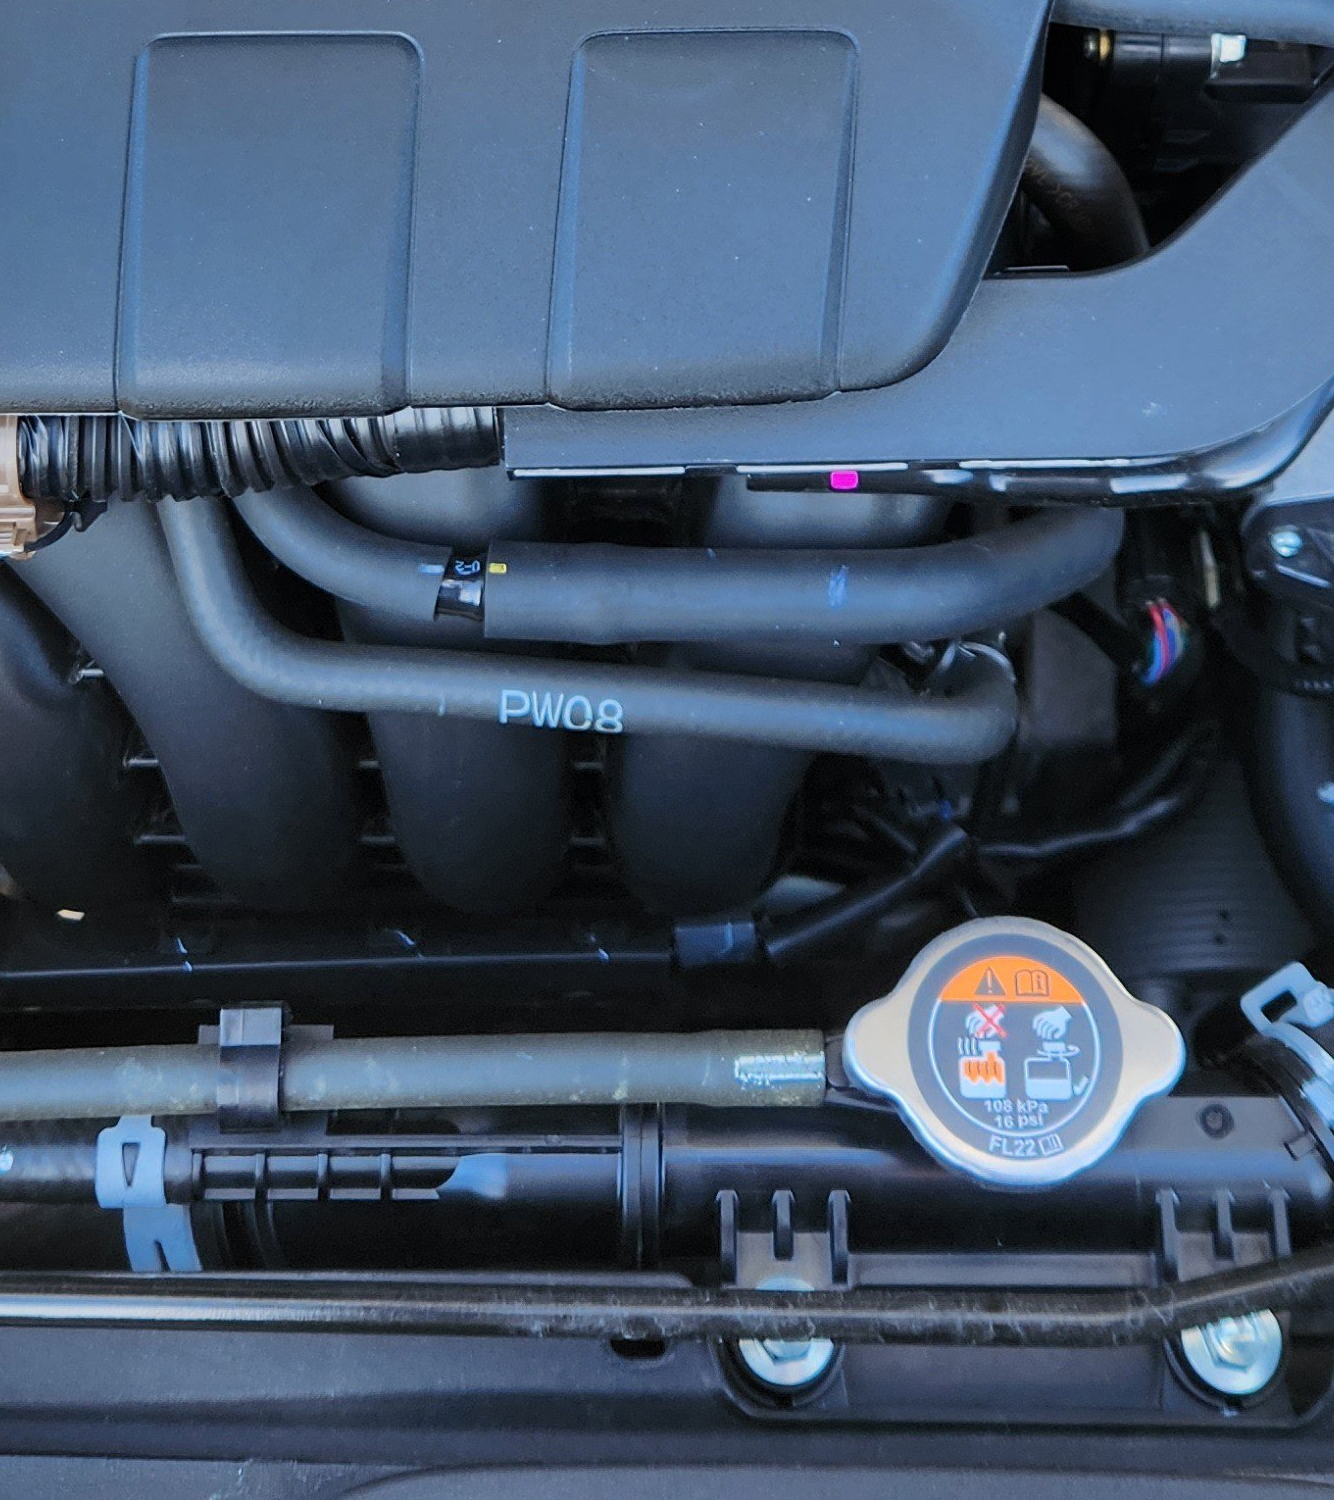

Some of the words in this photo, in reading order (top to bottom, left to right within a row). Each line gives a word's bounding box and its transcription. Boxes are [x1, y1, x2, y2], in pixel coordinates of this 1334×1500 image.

[984, 1100, 1013, 1113] 108
[1018, 1100, 1048, 1113] kPa
[995, 1116, 1014, 1128] 16
[1019, 1112, 1044, 1128] psi
[989, 1134, 1037, 1156] FL22
